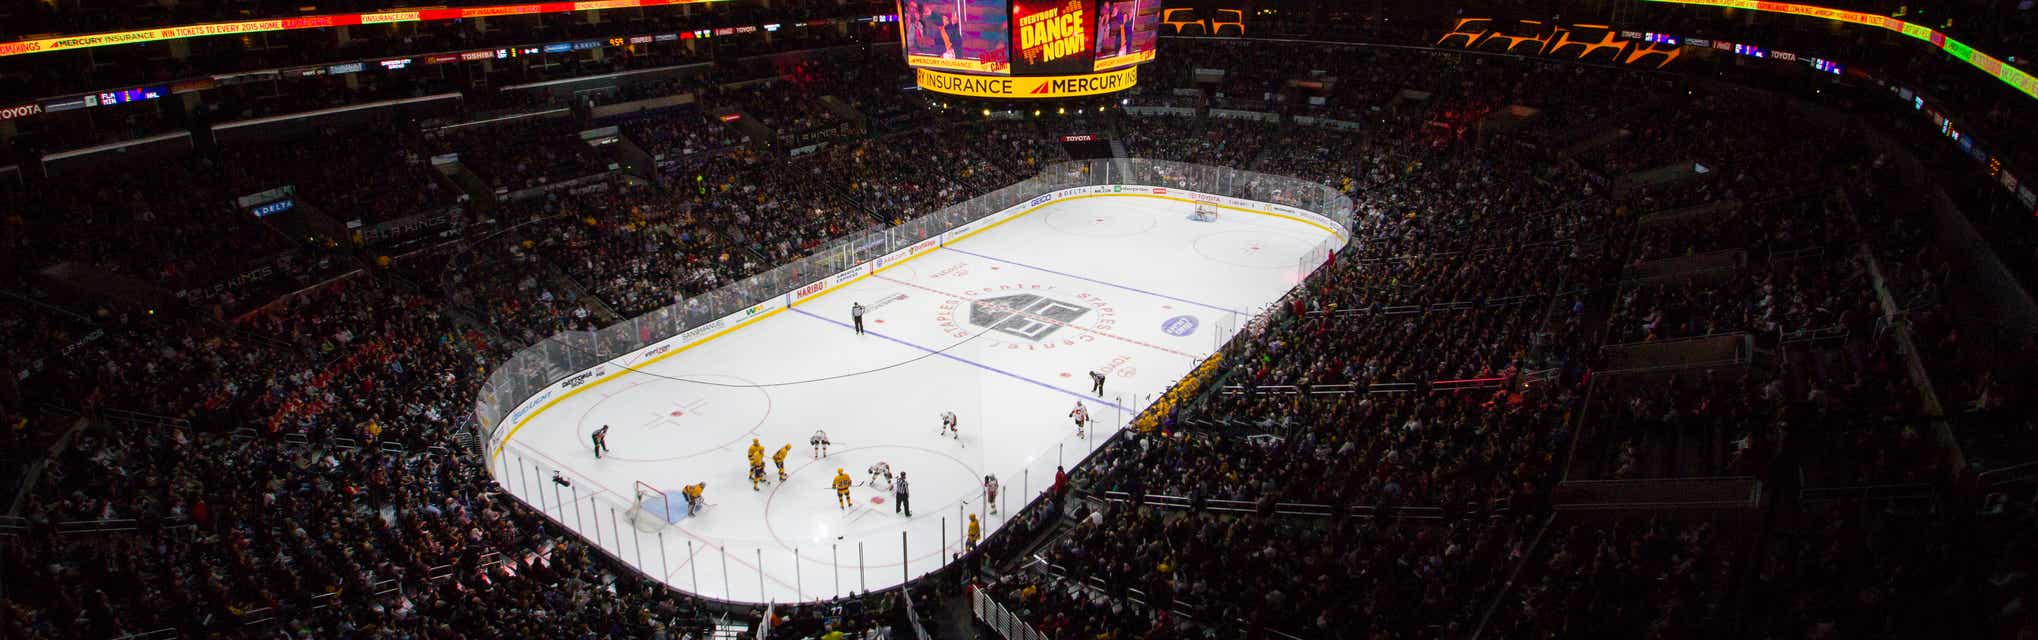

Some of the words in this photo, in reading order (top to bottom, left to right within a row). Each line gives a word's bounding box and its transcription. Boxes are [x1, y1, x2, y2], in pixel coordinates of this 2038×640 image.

[1020, 8, 1058, 26] EVERYBODY
[161, 28, 175, 37] WIN
[176, 26, 205, 36] TICKETS
[206, 25, 215, 34] TO
[216, 24, 239, 33] EVERY
[242, 23, 259, 31] 2015
[1020, 10, 1084, 50] DANCE
[58, 37, 102, 47] MERCURY
[104, 31, 155, 43] INSURANCE
[1042, 33, 1085, 62] NOW!
[1771, 50, 1796, 61] TOYOTA
[461, 51, 495, 61] TOSHIBA
[926, 73, 1013, 94] INSURANCE
[1053, 74, 1122, 93] MERCURY
[0, 104, 42, 120] TOYOTA
[263, 199, 293, 213] DELTA
[797, 281, 824, 299] HARIBO
